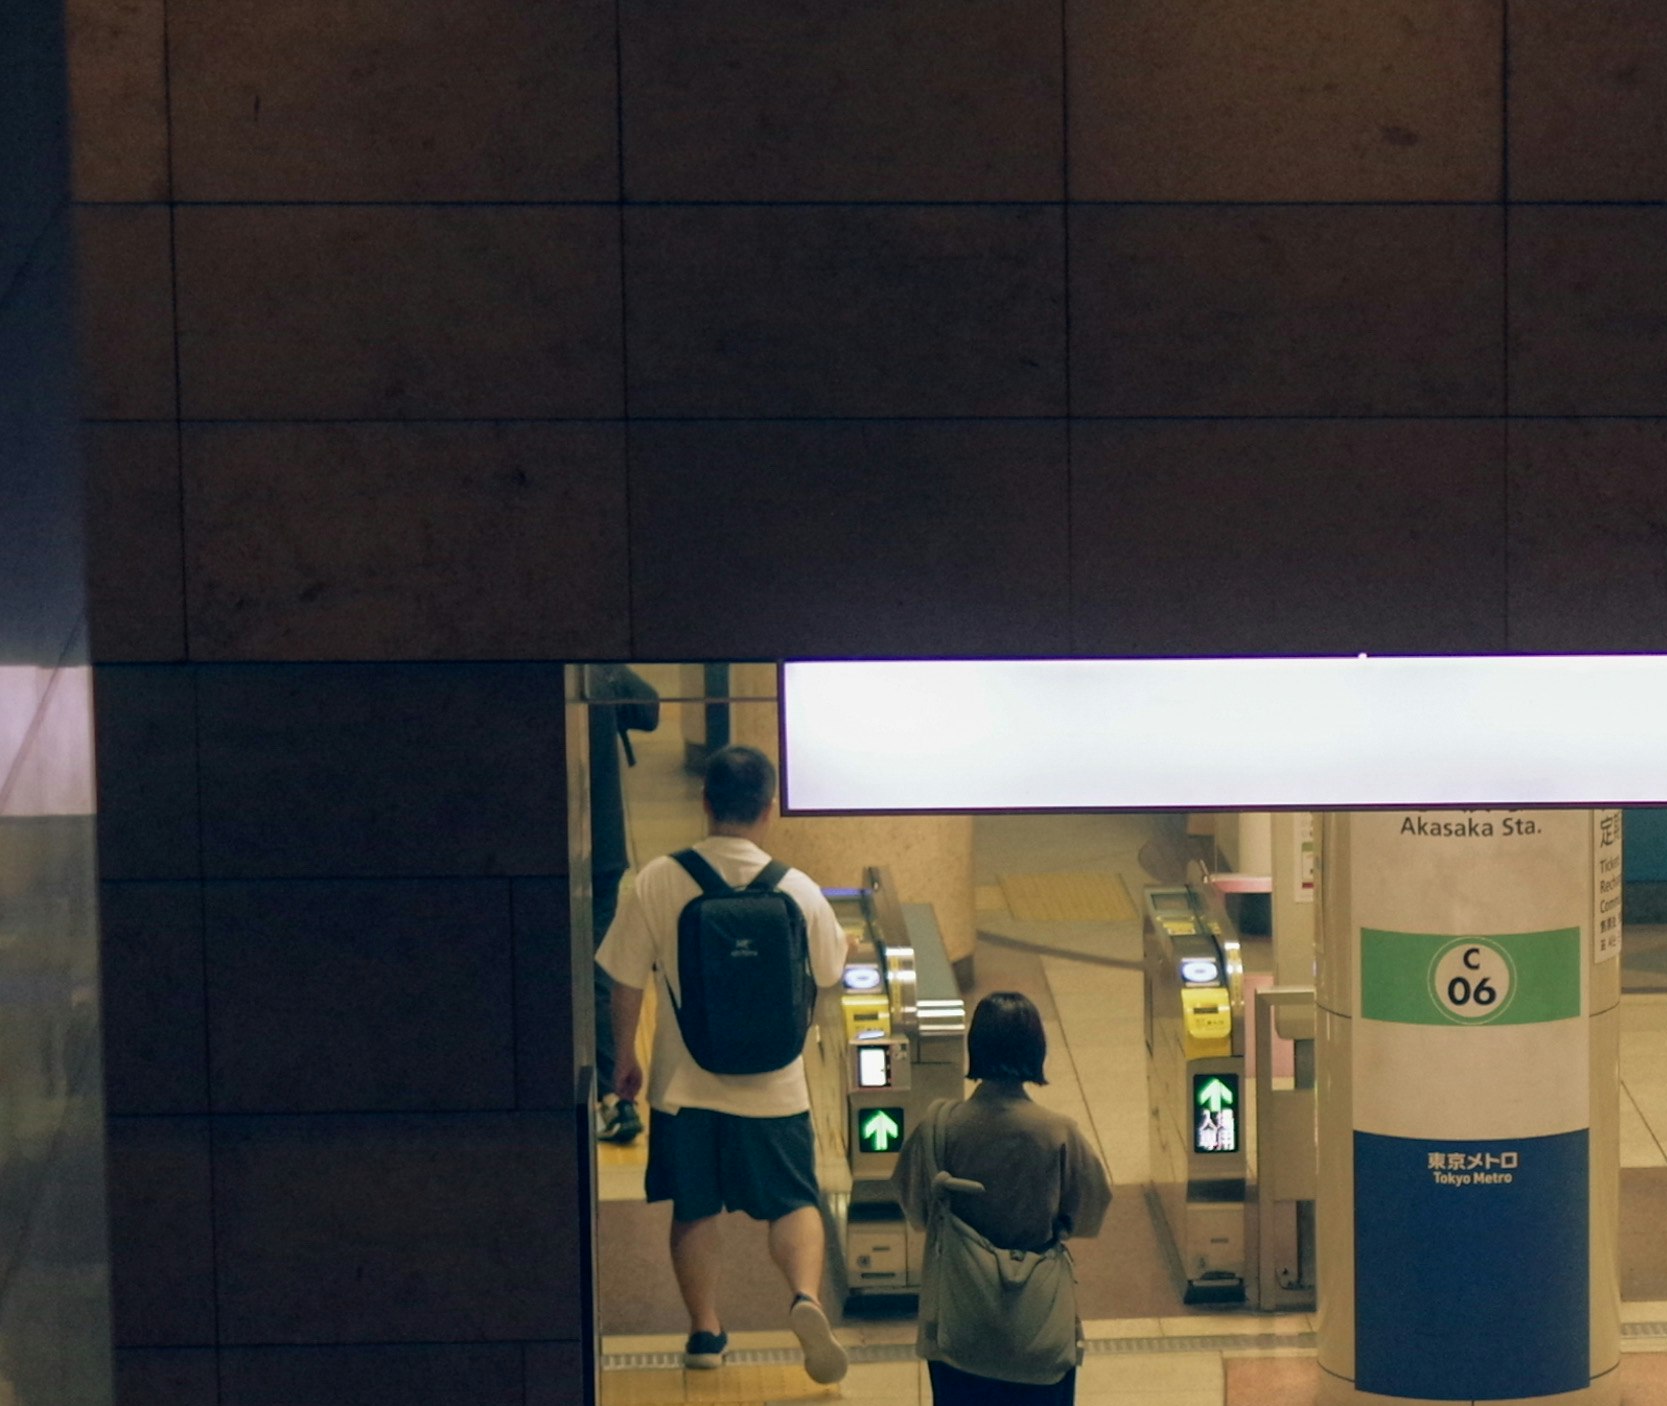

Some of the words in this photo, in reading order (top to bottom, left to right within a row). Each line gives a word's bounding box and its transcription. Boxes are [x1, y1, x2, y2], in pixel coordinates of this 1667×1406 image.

[1400, 816, 1494, 838] Akasaka
[1502, 817, 1542, 837] Sta.
[1463, 947, 1481, 971] C
[1447, 976, 1497, 1007] 06
[1427, 1151, 1519, 1171] 東京メトロ
[1433, 1171, 1471, 1188] Tokyo
[1473, 1172, 1513, 1185] Metro
